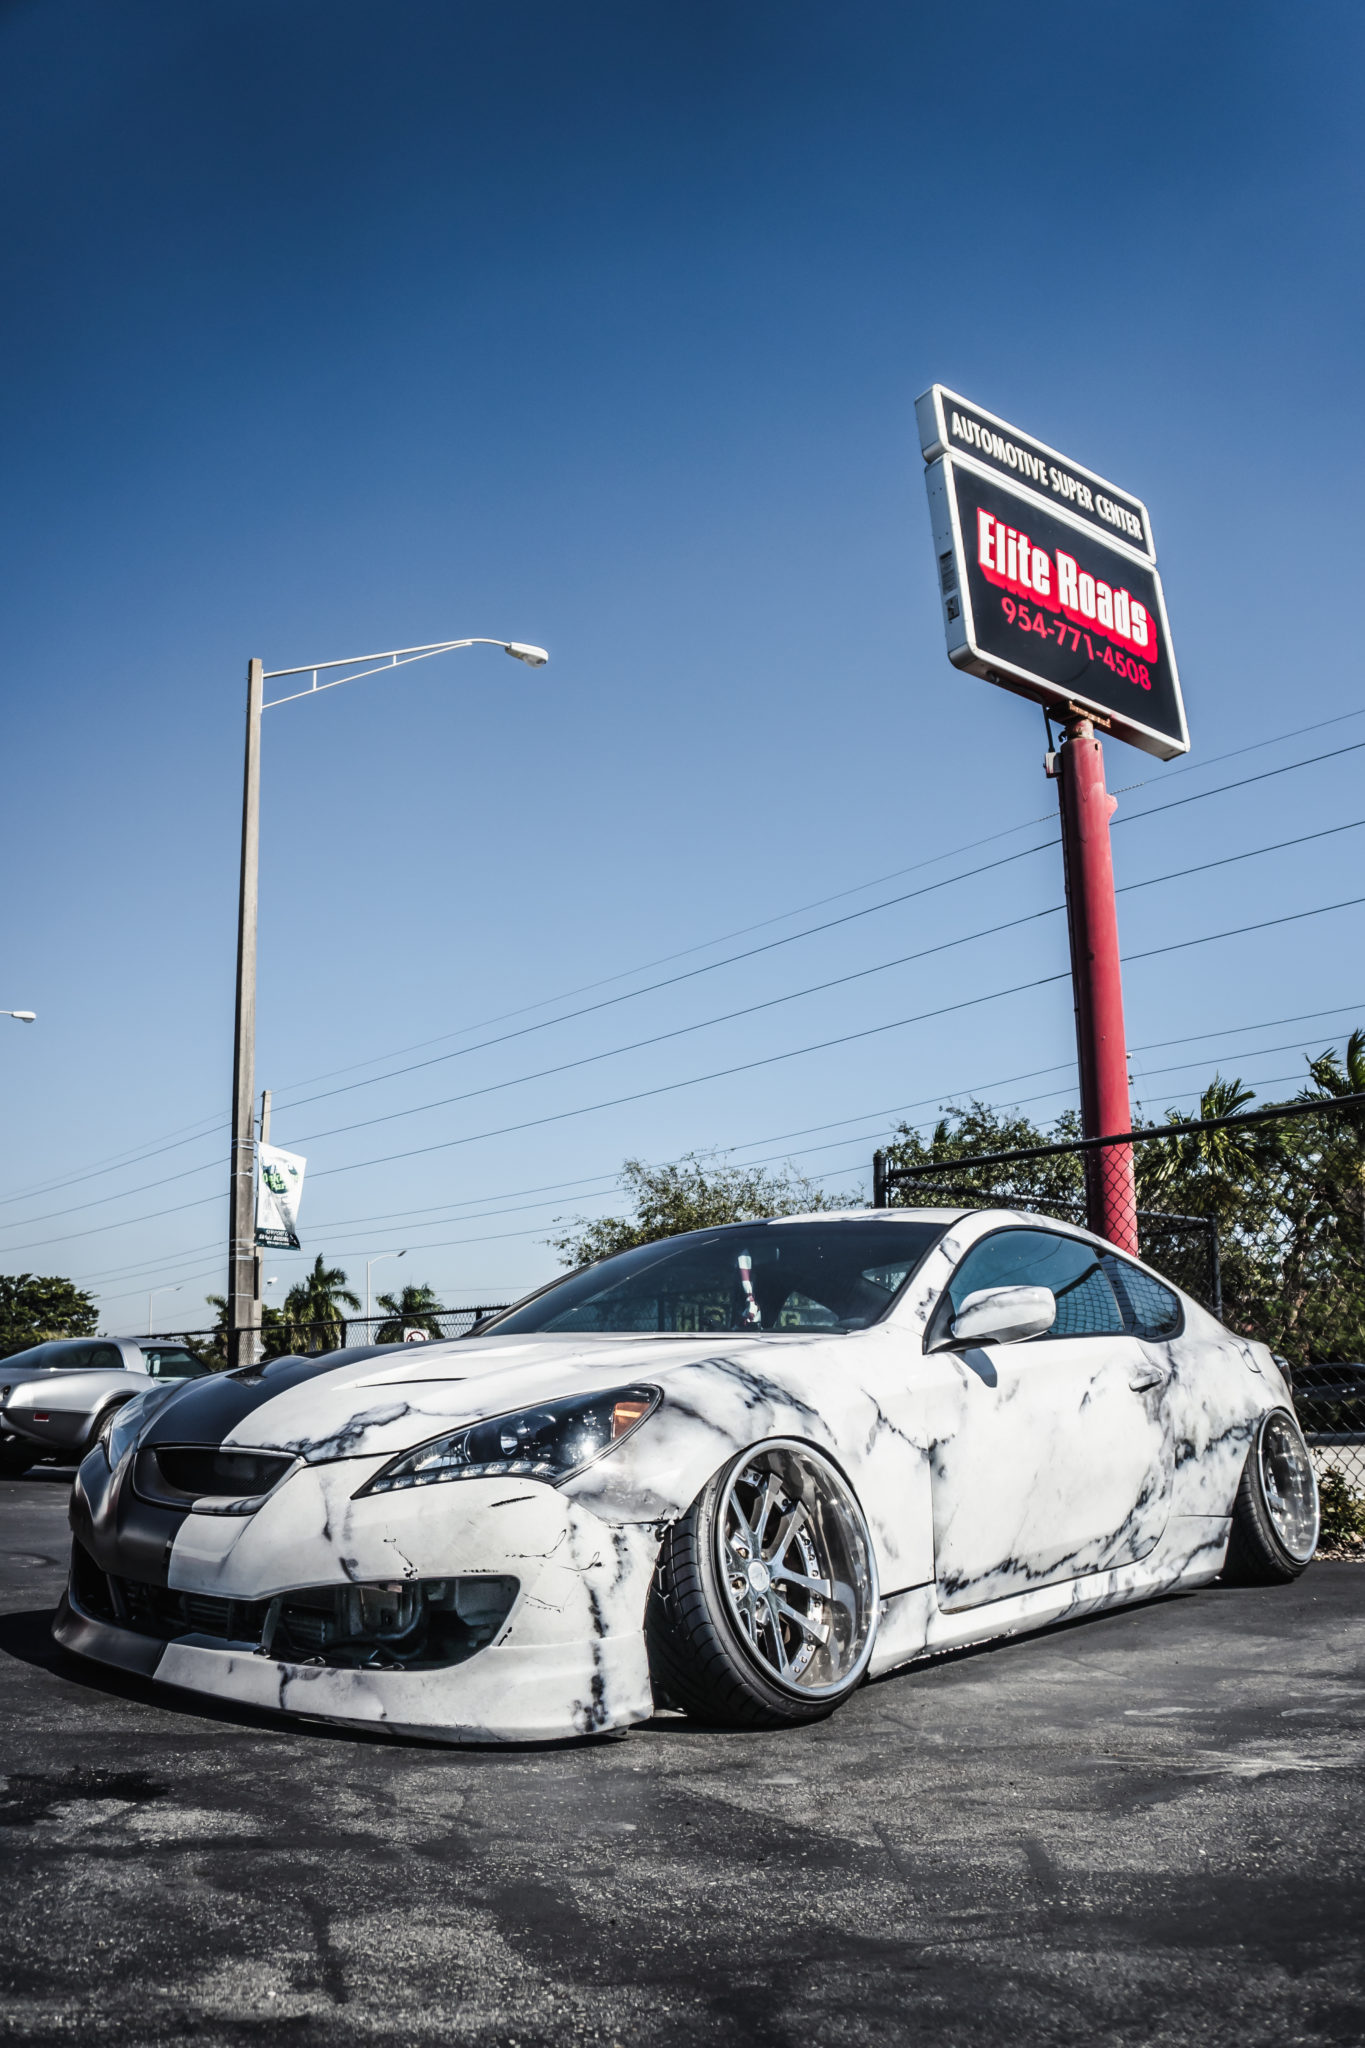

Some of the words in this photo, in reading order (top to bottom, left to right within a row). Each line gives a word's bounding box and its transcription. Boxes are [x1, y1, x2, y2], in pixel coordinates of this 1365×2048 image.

[952, 411, 1049, 486] AUTOMOTIVE
[1049, 467, 1094, 512] SUPER
[1095, 494, 1143, 540] CENTER
[978, 509, 1051, 597] Elite
[1056, 550, 1149, 648] Roads
[1001, 597, 1152, 691] 954-771-4508
